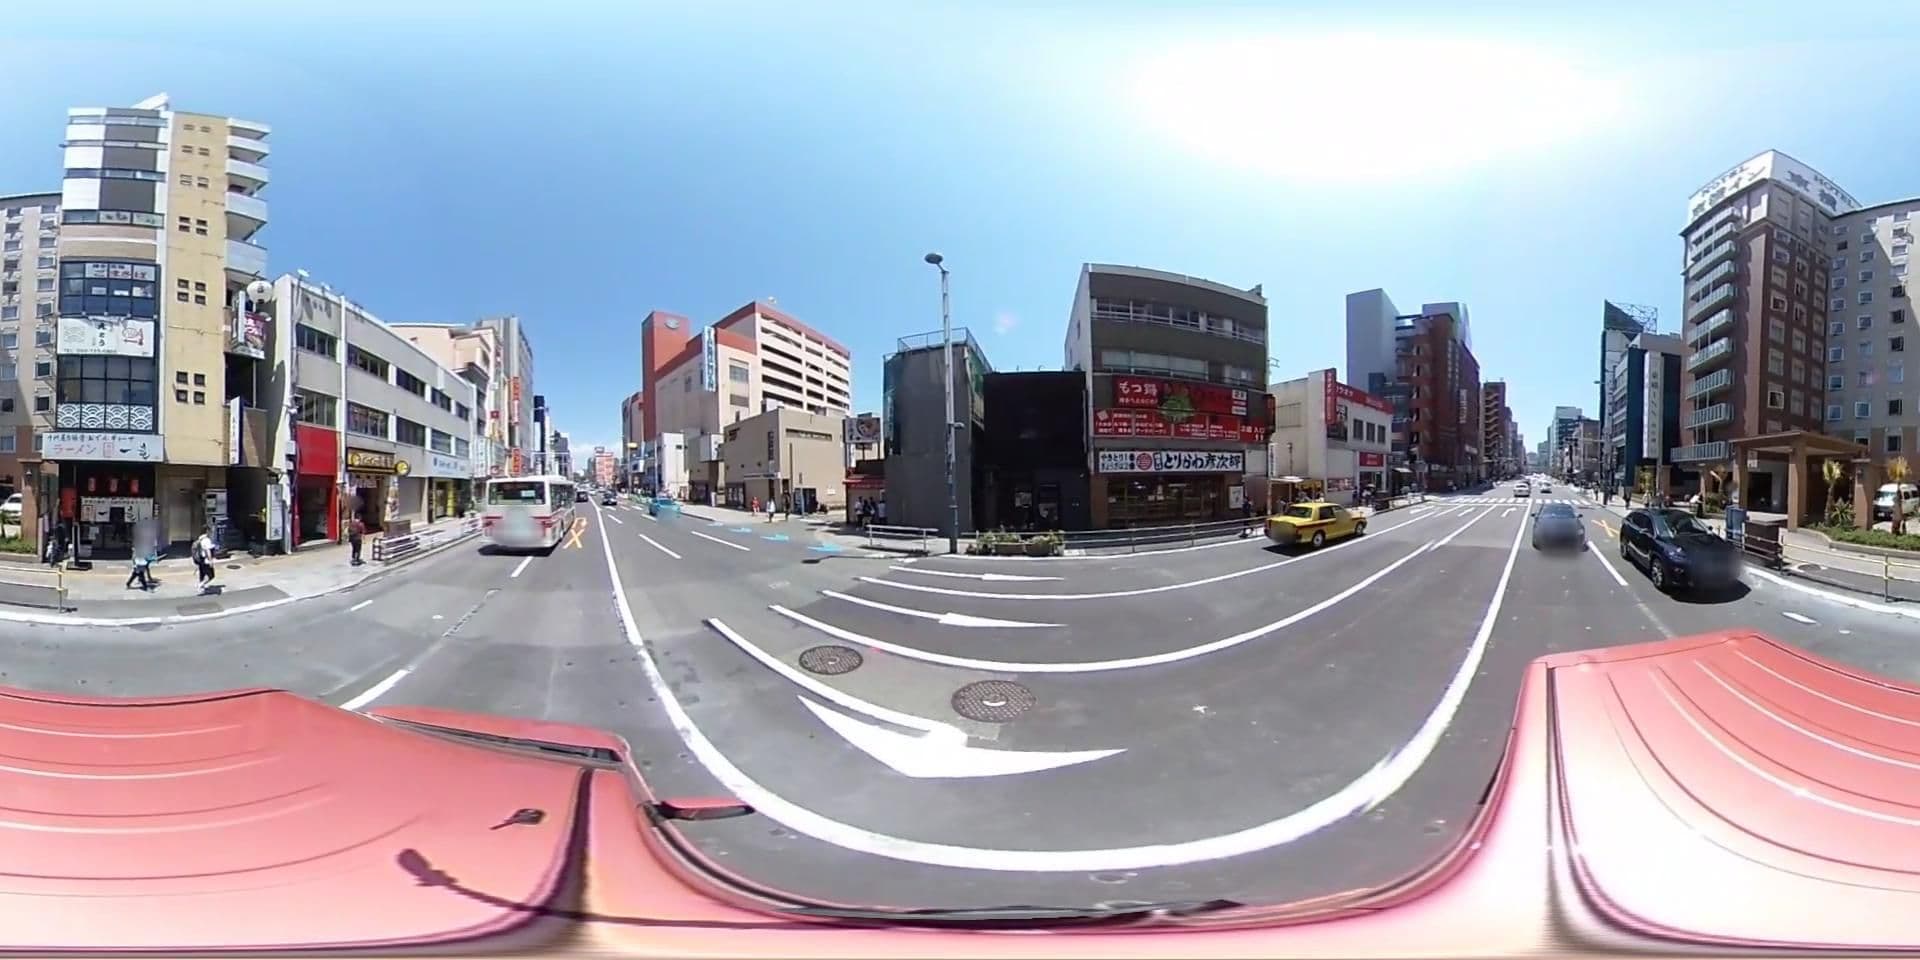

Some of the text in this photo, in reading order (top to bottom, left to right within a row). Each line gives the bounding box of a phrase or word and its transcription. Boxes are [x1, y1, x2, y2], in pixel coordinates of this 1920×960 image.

[1120, 381, 1157, 396] もつ鍋
[54, 444, 96, 455] ラーメン
